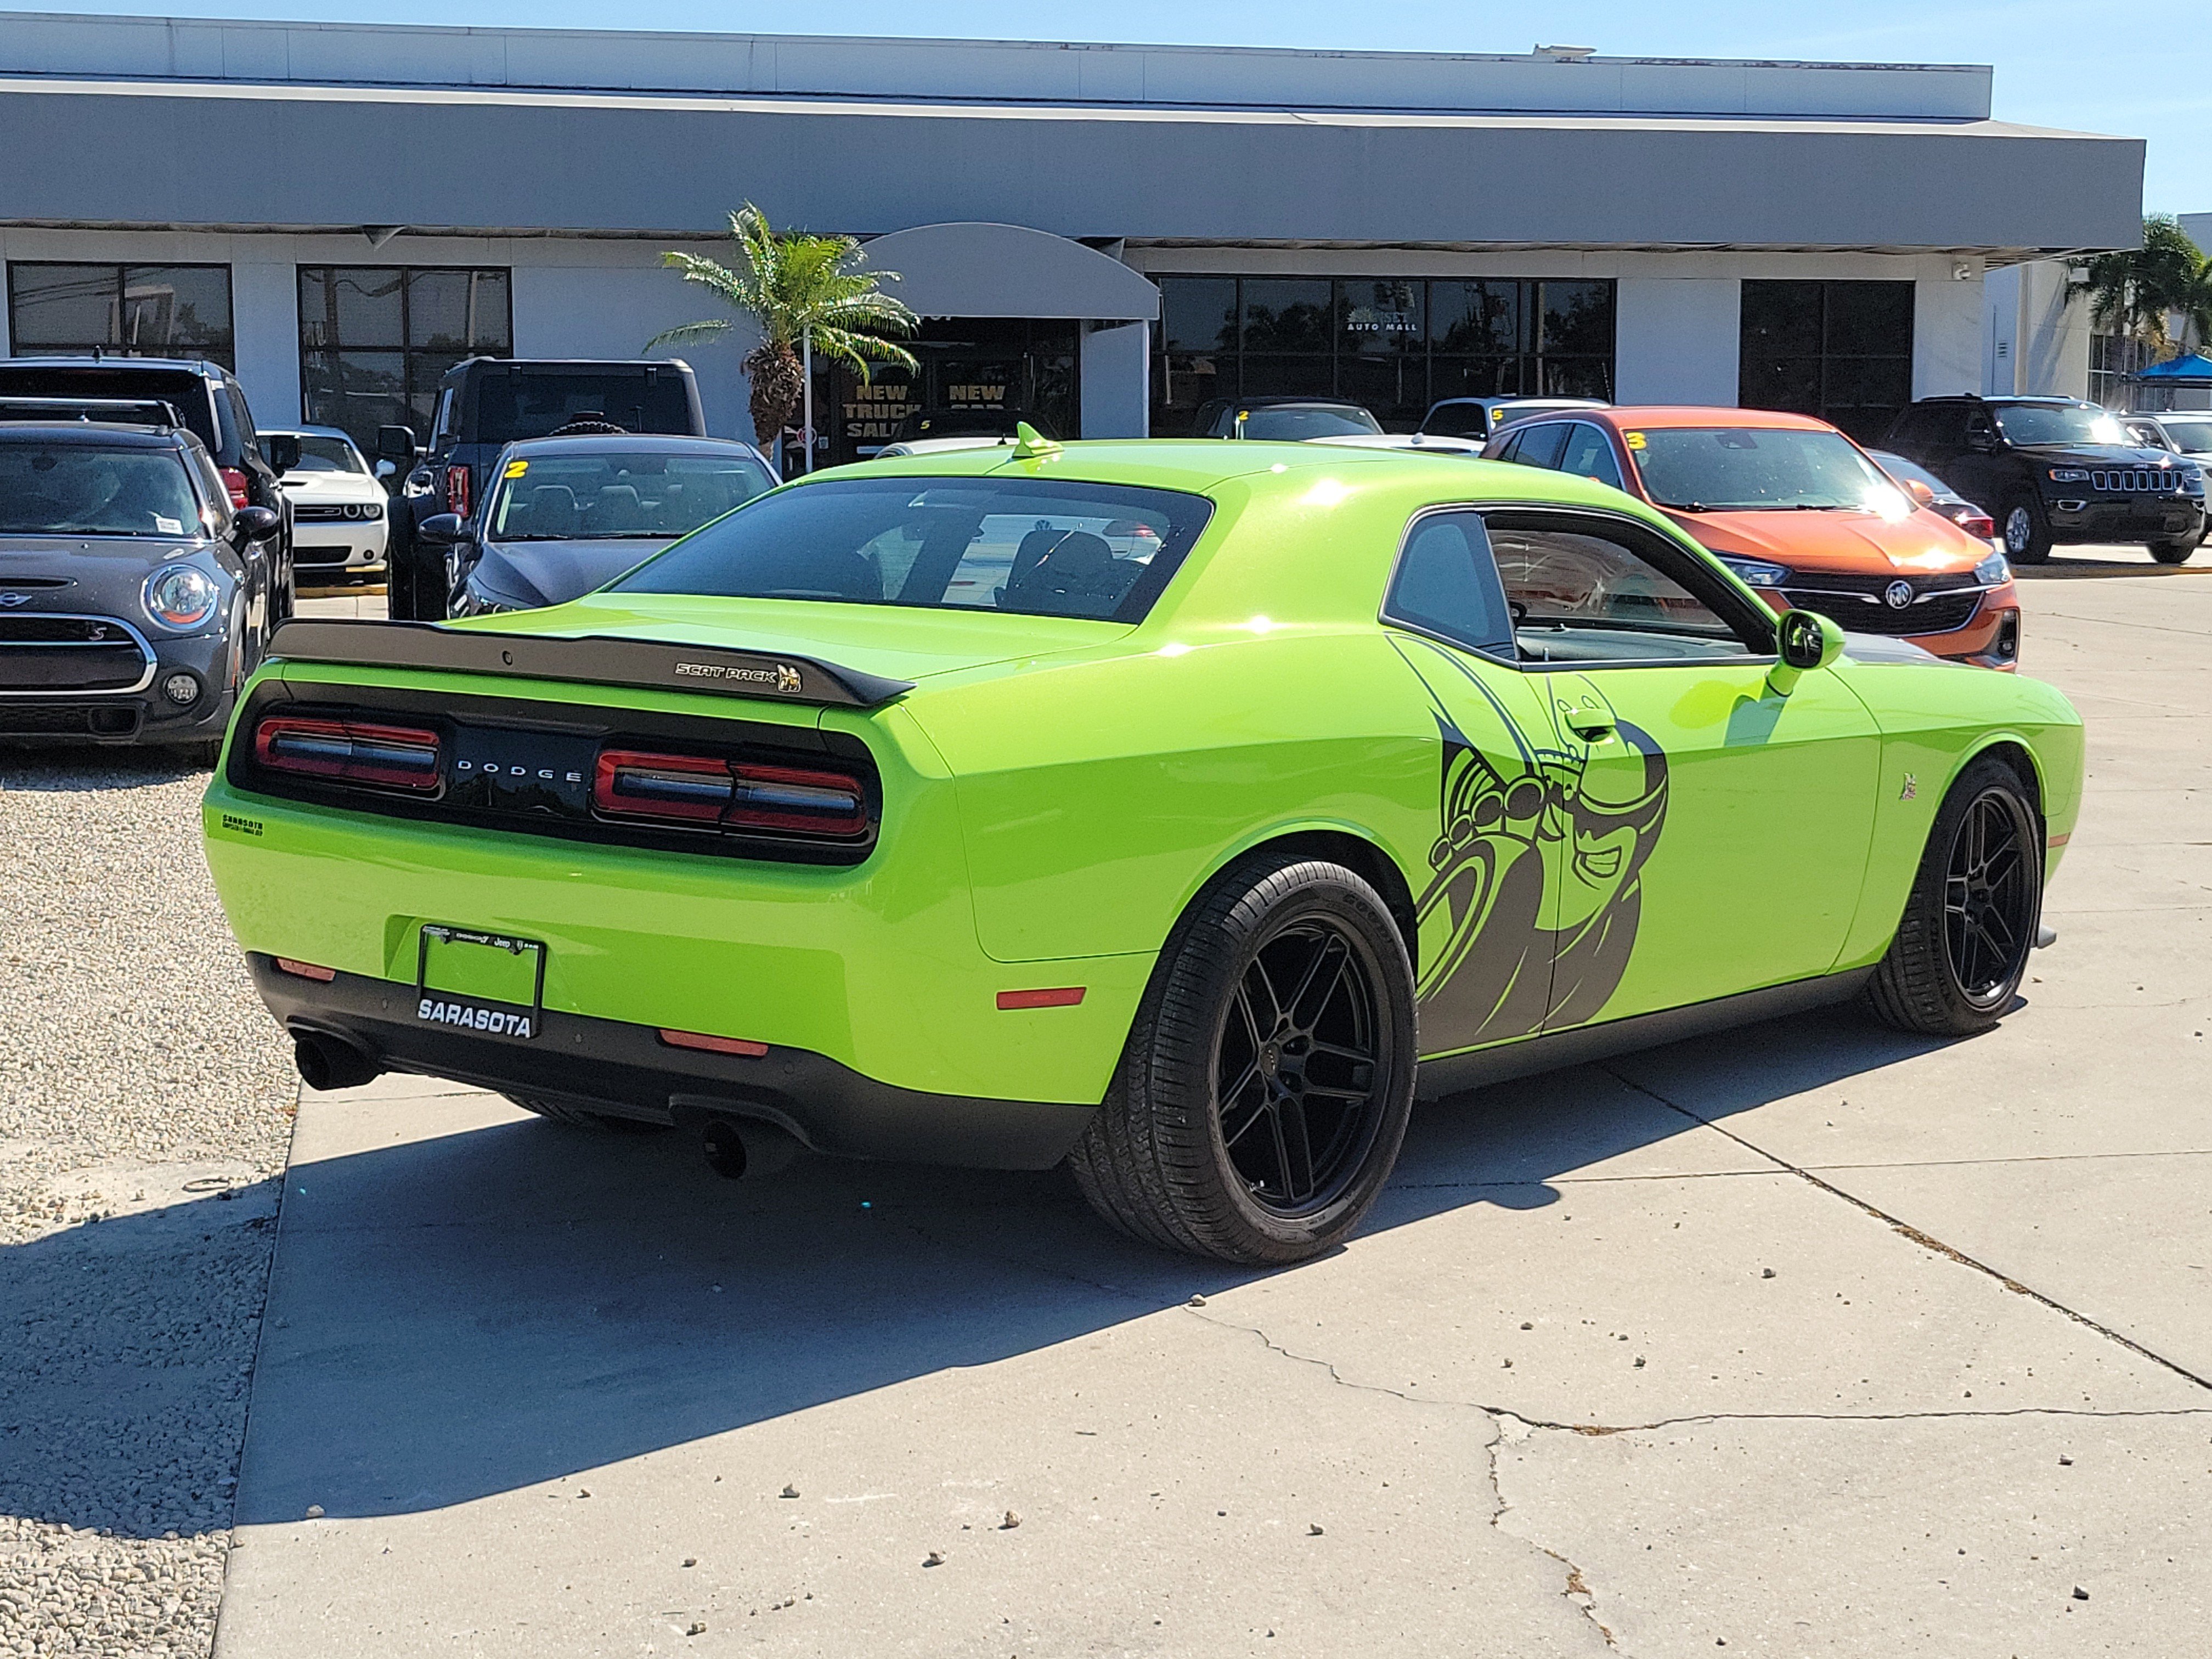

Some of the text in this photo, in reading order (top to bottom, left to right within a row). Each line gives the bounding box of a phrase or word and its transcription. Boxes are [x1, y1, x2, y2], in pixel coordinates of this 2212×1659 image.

[856, 385, 908, 400] NEW
[949, 385, 1006, 400] NEW
[1238, 410, 1249, 420] 2
[1492, 409, 1503, 420] 5
[1626, 432, 1646, 449] 3
[504, 461, 528, 478] 2
[675, 663, 777, 684] SCAT PACK
[458, 760, 582, 782] DODGE
[494, 938, 511, 947] Jeep
[417, 998, 531, 1039] SARASOTA
